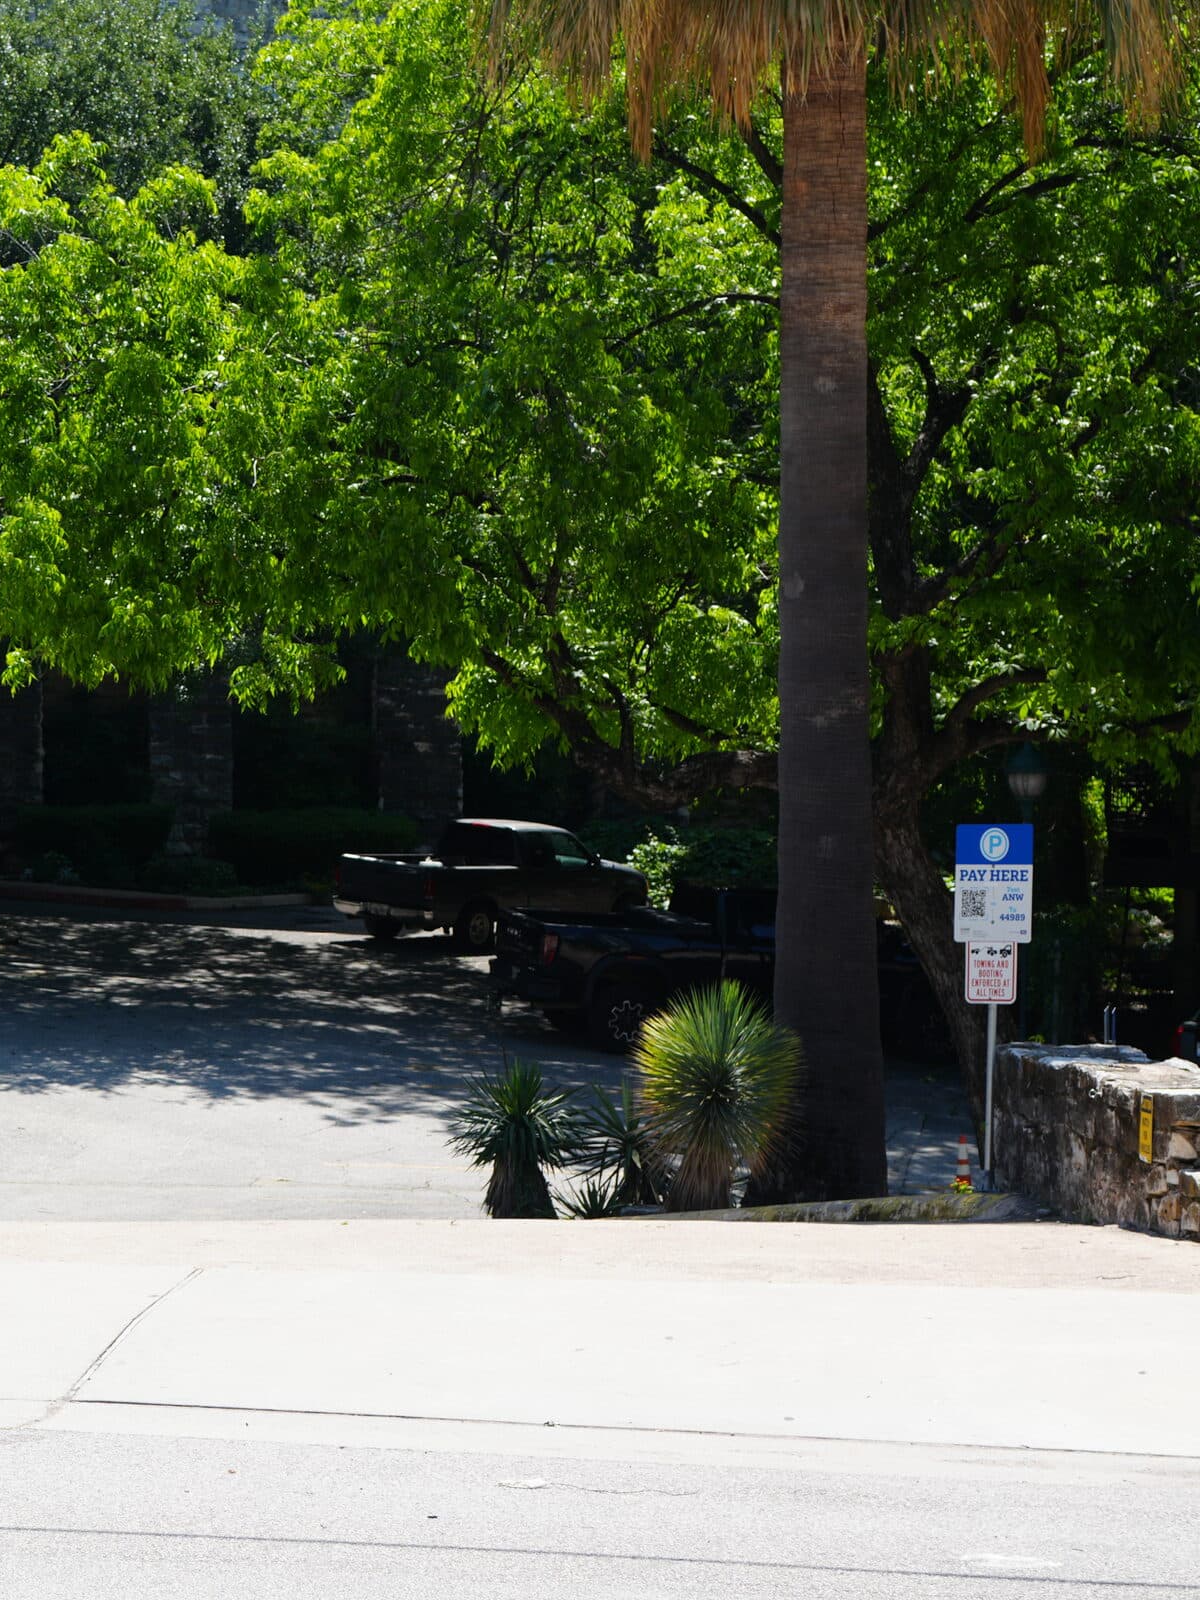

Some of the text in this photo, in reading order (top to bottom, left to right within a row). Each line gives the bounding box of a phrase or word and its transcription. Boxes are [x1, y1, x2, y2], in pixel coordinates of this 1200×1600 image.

[989, 835, 1003, 854] P
[960, 869, 1029, 882] PAY HERE
[1002, 893, 1024, 901] ANW
[999, 913, 1026, 921] 44989
[974, 960, 1009, 968] TOWING AND
[978, 969, 1003, 977] BOOTING
[971, 979, 1010, 987] ENFORCED AT
[976, 988, 1005, 996] ALL TIMES
